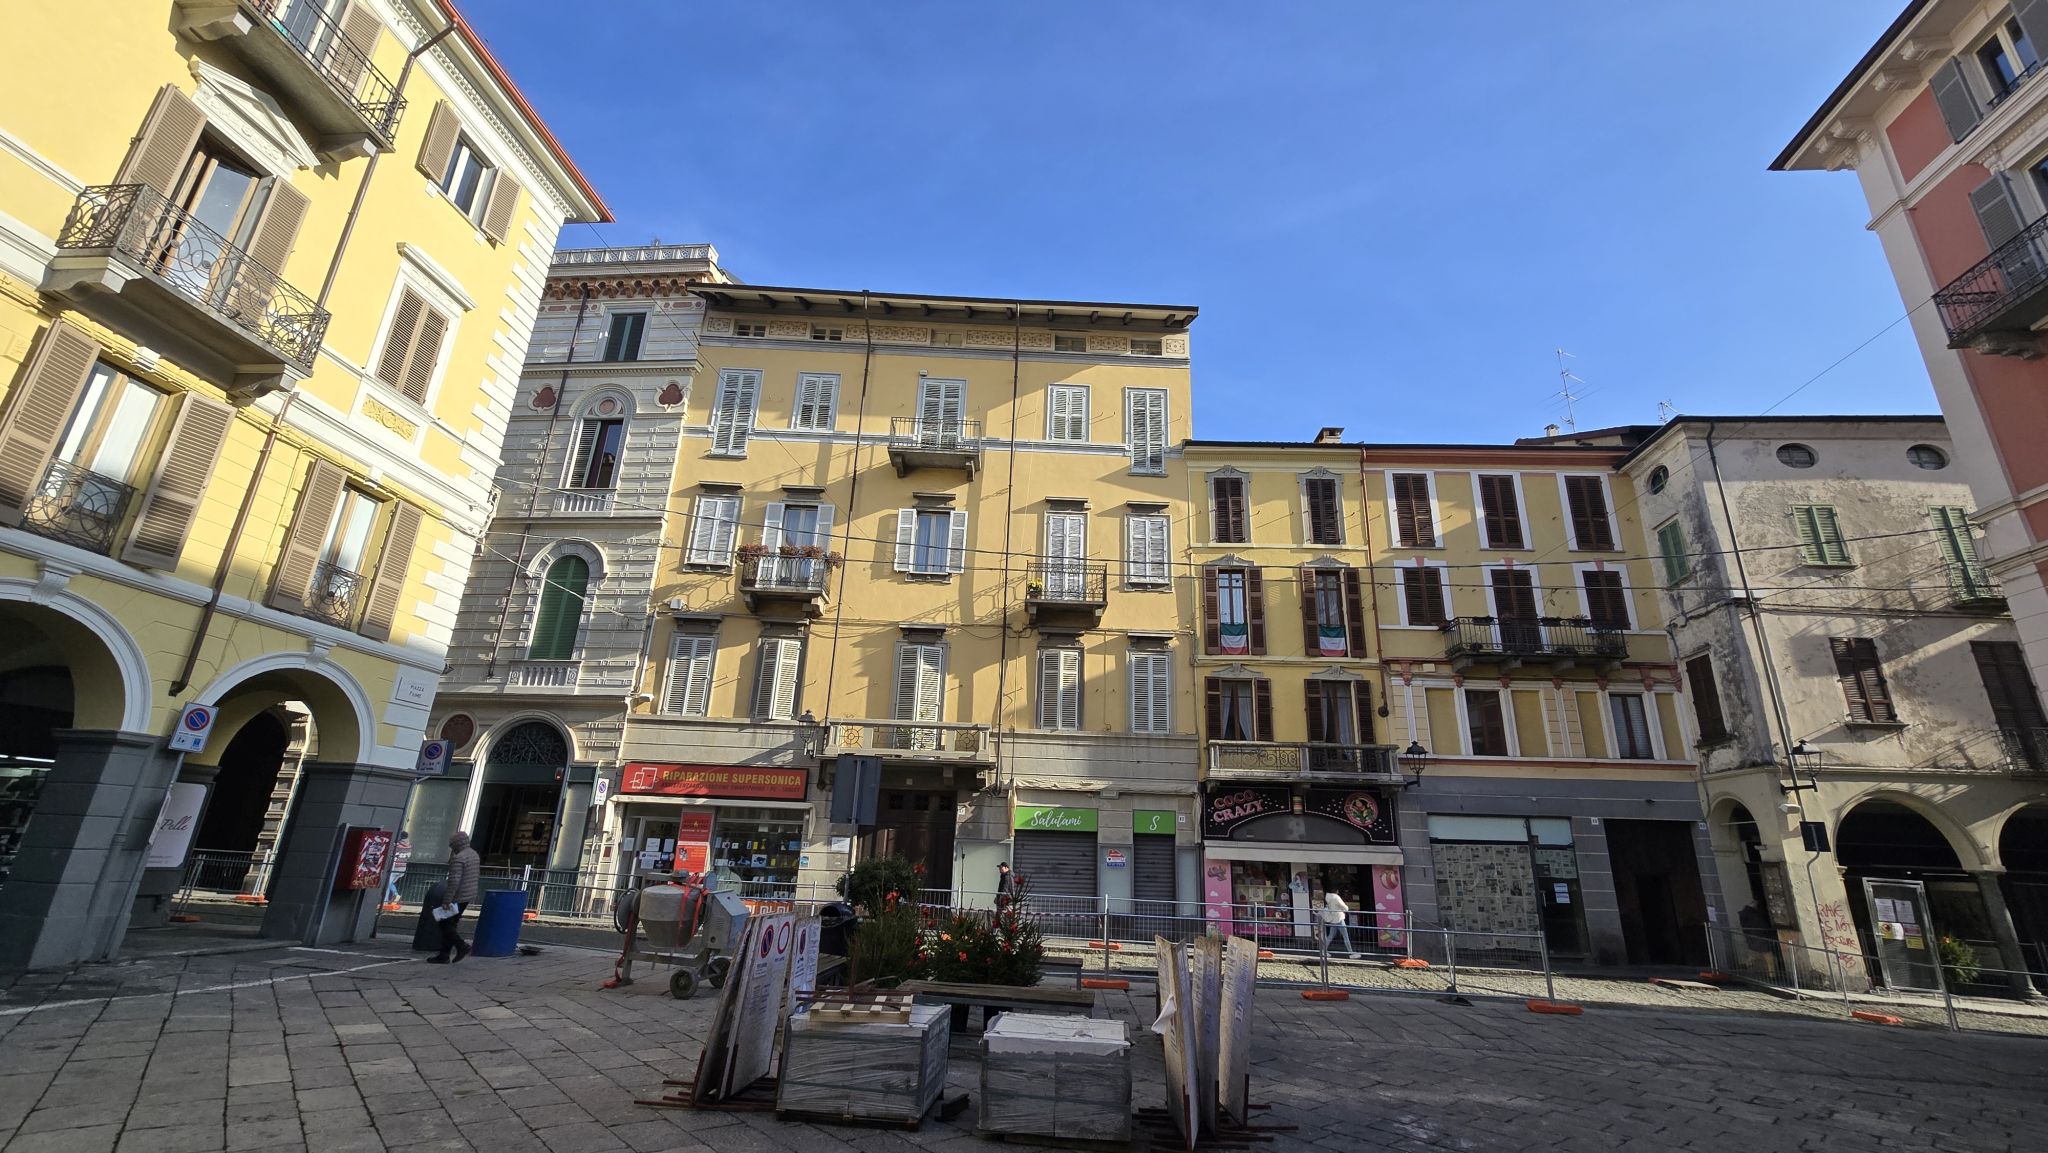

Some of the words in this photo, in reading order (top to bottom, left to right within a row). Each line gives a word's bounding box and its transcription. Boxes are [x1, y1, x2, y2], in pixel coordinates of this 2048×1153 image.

[662, 770, 729, 783] RIPARAZIONE
[731, 773, 801, 786] SUPERSONICA
[1214, 789, 1255, 810] COCO
[1031, 810, 1082, 827] Salutami
[1213, 799, 1264, 823] CRAZY
[1149, 815, 1160, 831] S
